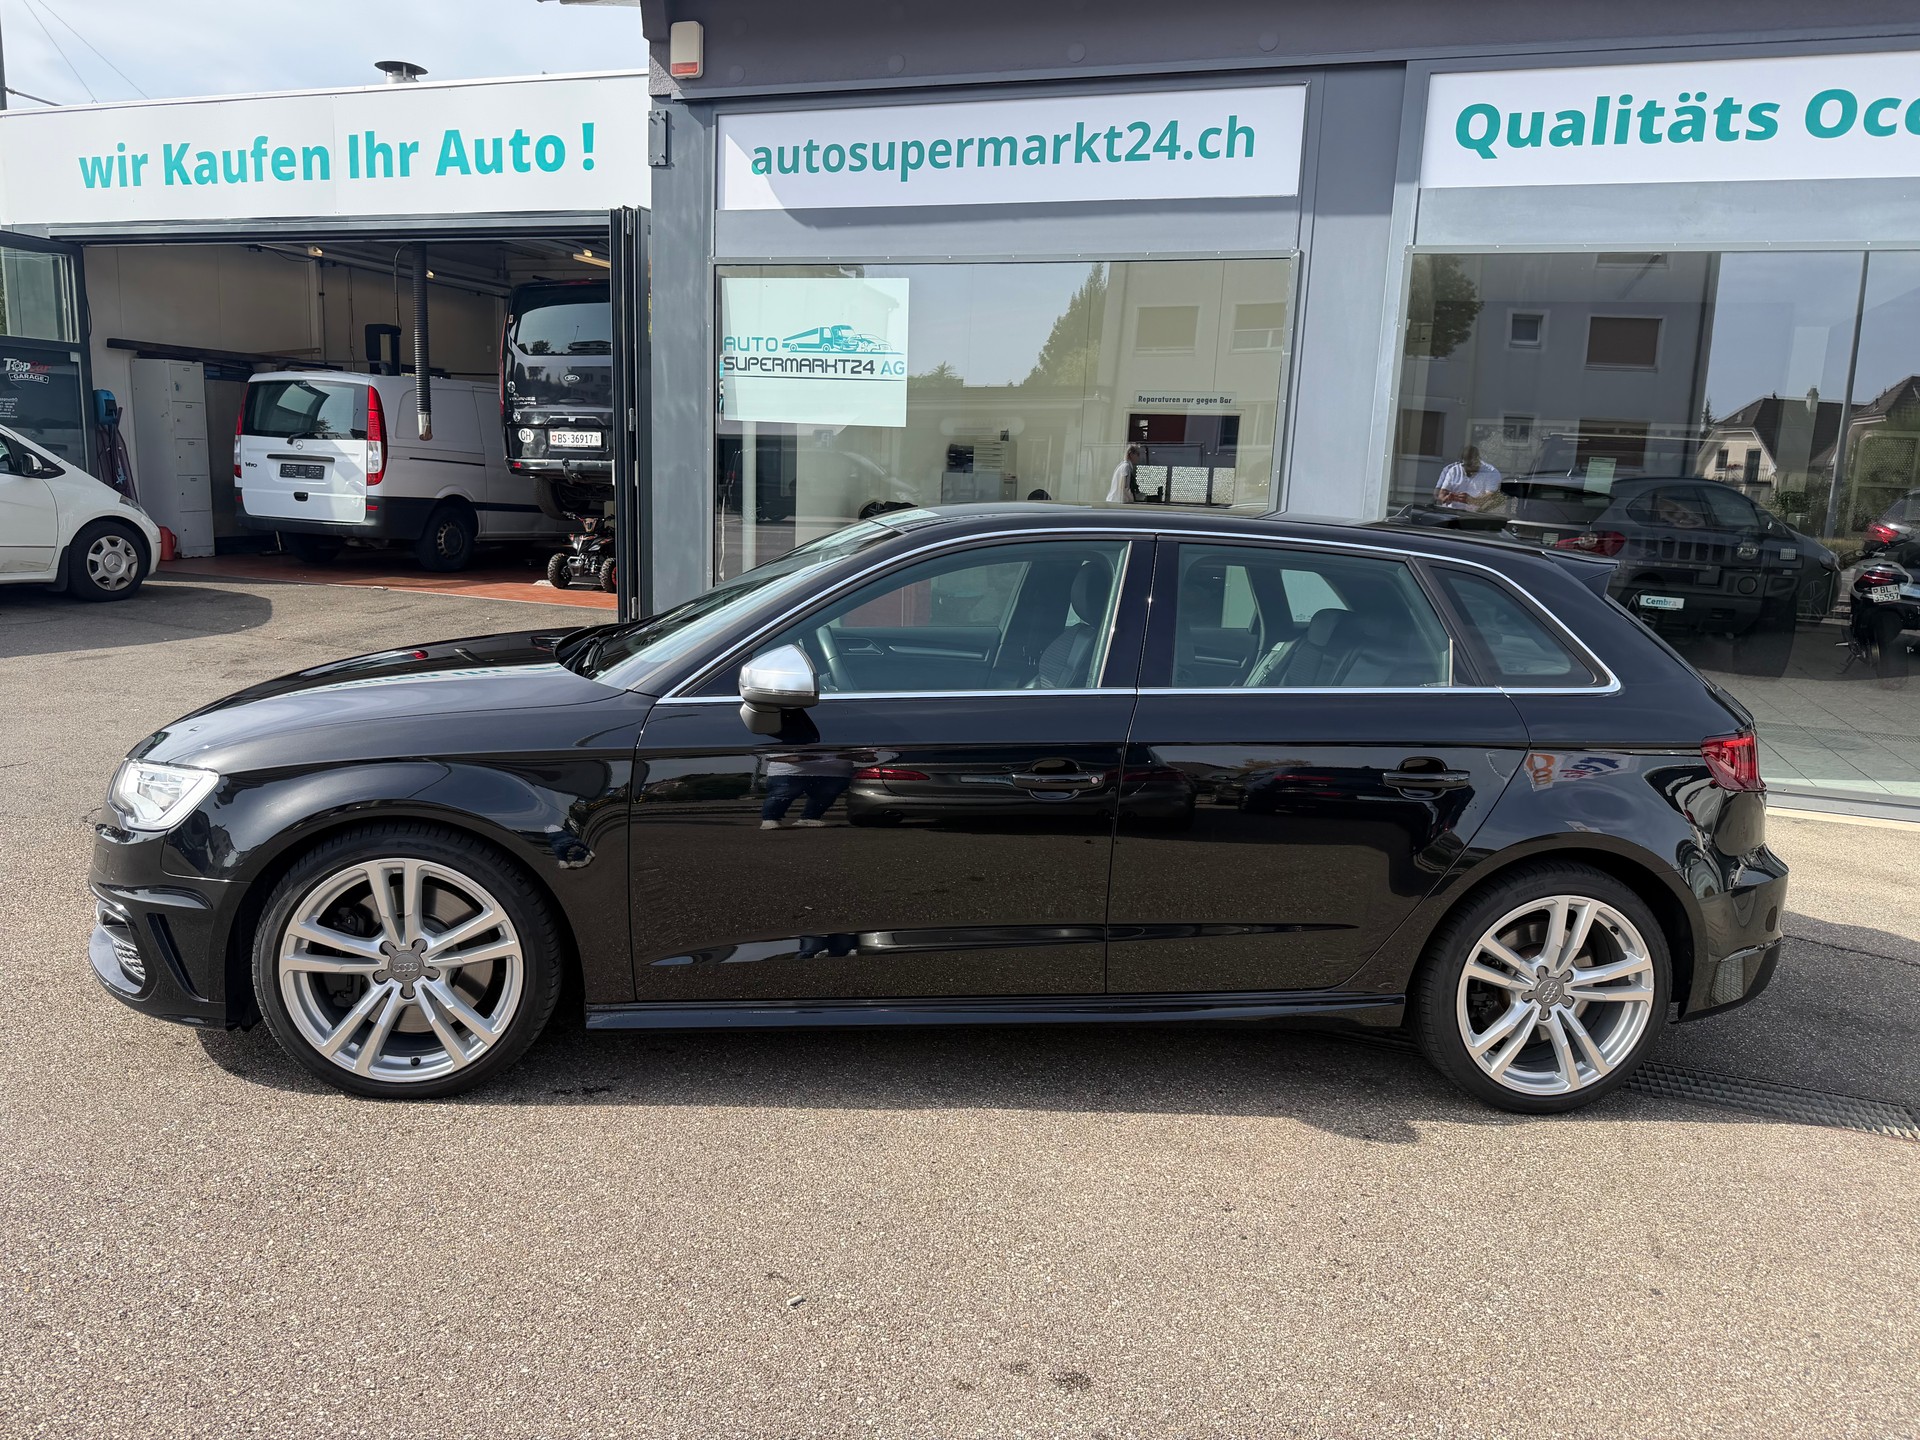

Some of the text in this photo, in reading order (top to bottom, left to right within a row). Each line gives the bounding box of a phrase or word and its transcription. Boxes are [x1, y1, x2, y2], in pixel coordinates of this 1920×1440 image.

[1456, 92, 1780, 159] Qualitäts
[752, 116, 1254, 182] autosupermarkt24.ch
[80, 144, 148, 188] wir
[164, 136, 330, 185] Kaufen
[349, 131, 418, 178] Ihr
[436, 130, 565, 176] Auto
[724, 336, 778, 352] AUTO
[723, 356, 905, 375] SUPERMARKT24 AG
[13, 373, 45, 382] GARAGE
[1138, 395, 1181, 405] Reparaturen
[1196, 397, 1218, 405] gegen
[1220, 396, 1232, 404] Bar
[520, 429, 532, 441] CH
[1645, 597, 1677, 606] Cembra
